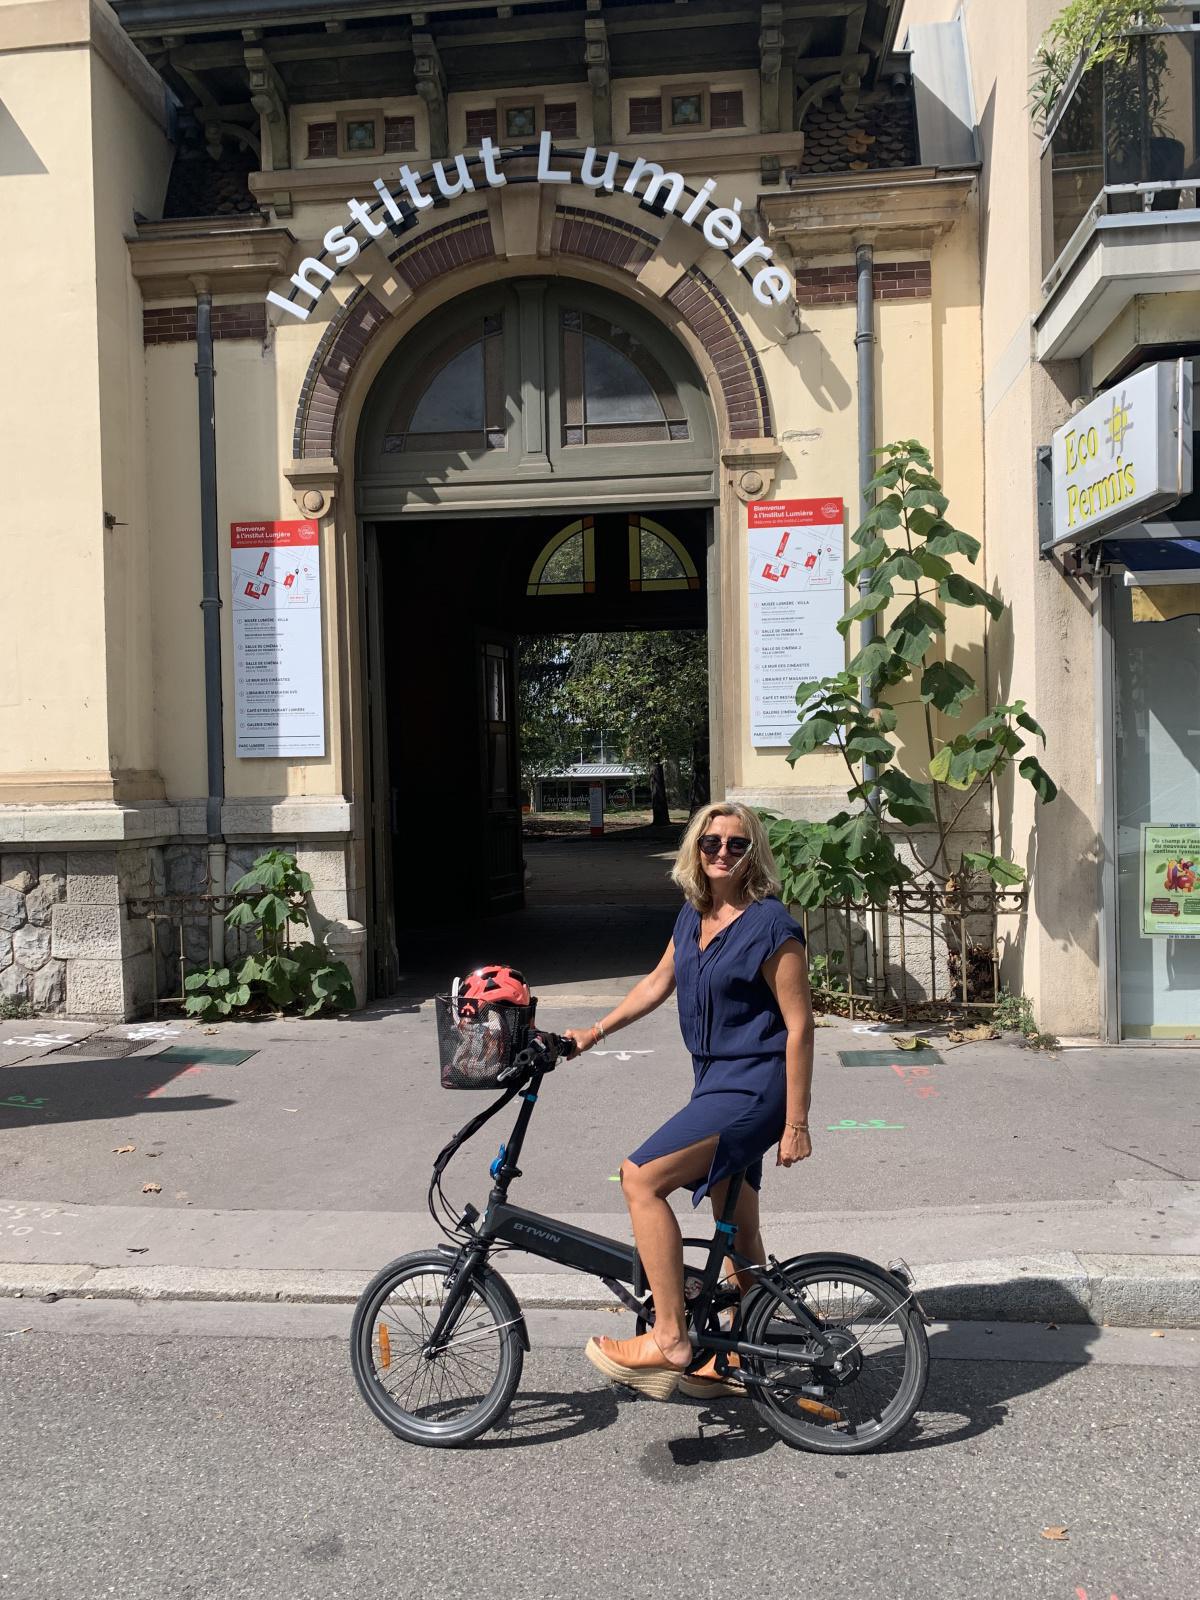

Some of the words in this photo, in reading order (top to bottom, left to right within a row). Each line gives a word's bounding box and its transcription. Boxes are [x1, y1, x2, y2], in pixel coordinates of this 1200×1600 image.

[266, 137, 507, 320] Institut
[537, 131, 791, 305] Lumière
[1064, 426, 1099, 476] Eco
[1066, 455, 1137, 529] Permis
